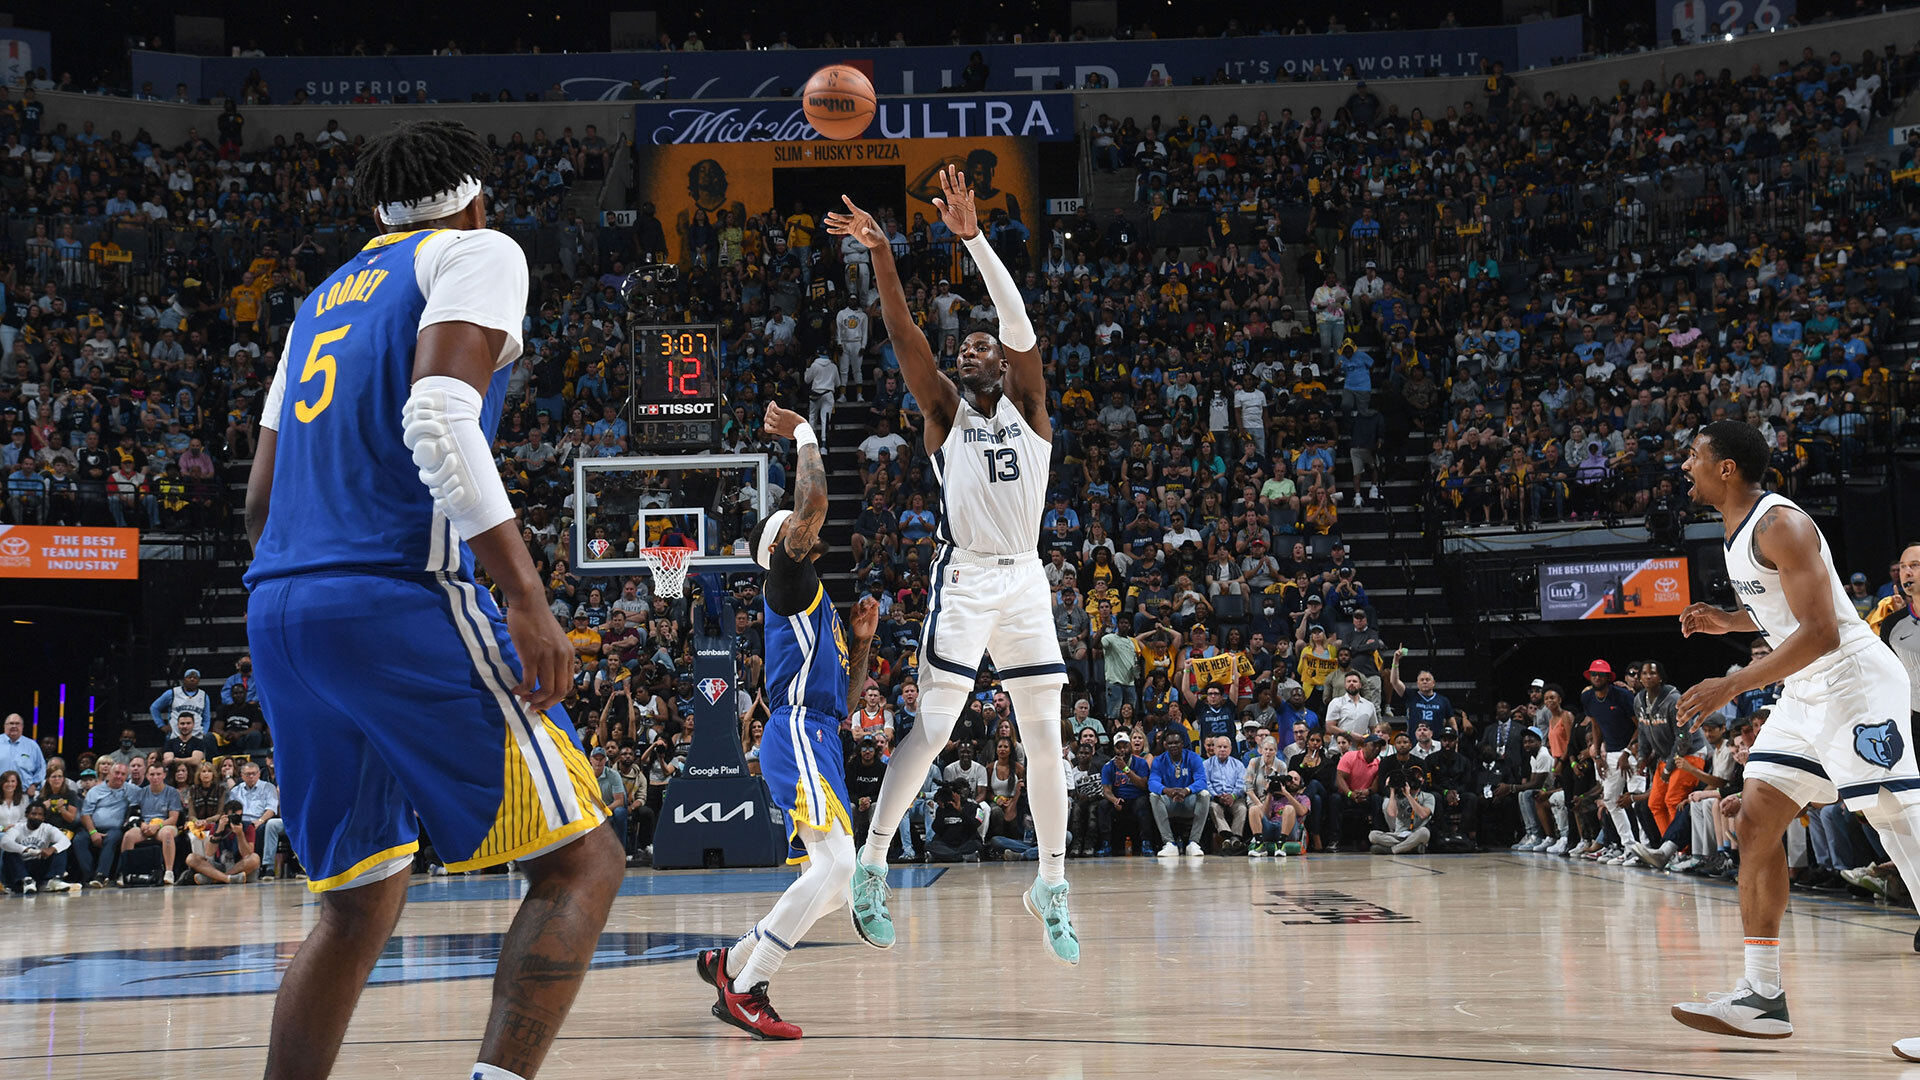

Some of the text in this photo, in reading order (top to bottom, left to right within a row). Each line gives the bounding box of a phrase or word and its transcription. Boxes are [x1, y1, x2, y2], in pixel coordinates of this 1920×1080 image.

[1224, 52, 1479, 76] IT'S ONLY WORTH IT
[306, 80, 427, 95] SUPERIOR
[652, 100, 1055, 145] Michelo ULTRA
[774, 146, 803, 161] SLIM
[814, 144, 864, 161] HUSKY'S
[867, 143, 901, 160] PIZZA
[1056, 201, 1077, 212] 118
[616, 213, 631, 225] 01
[315, 269, 390, 318] LOONEY
[661, 333, 708, 356] 3:07
[295, 323, 352, 424] 5
[668, 357, 702, 395] 12
[660, 403, 715, 415] TISSOT
[983, 447, 1020, 484] 13
[53, 535, 116, 546] THE BEST
[41, 547, 127, 559] TEAM IN THE
[47, 560, 119, 571] INDUSTRY
[1547, 560, 1680, 576] THE BEST TEAM IN THE INDUSTRY
[1550, 586, 1574, 598] LILLY
[1196, 656, 1231, 673] WE HERE
[1319, 659, 1337, 670] HERE
[1421, 710, 1434, 721] 12
[1211, 722, 1228, 734] 22
[689, 765, 740, 777] Google Pixel
[674, 801, 754, 823] KIA
